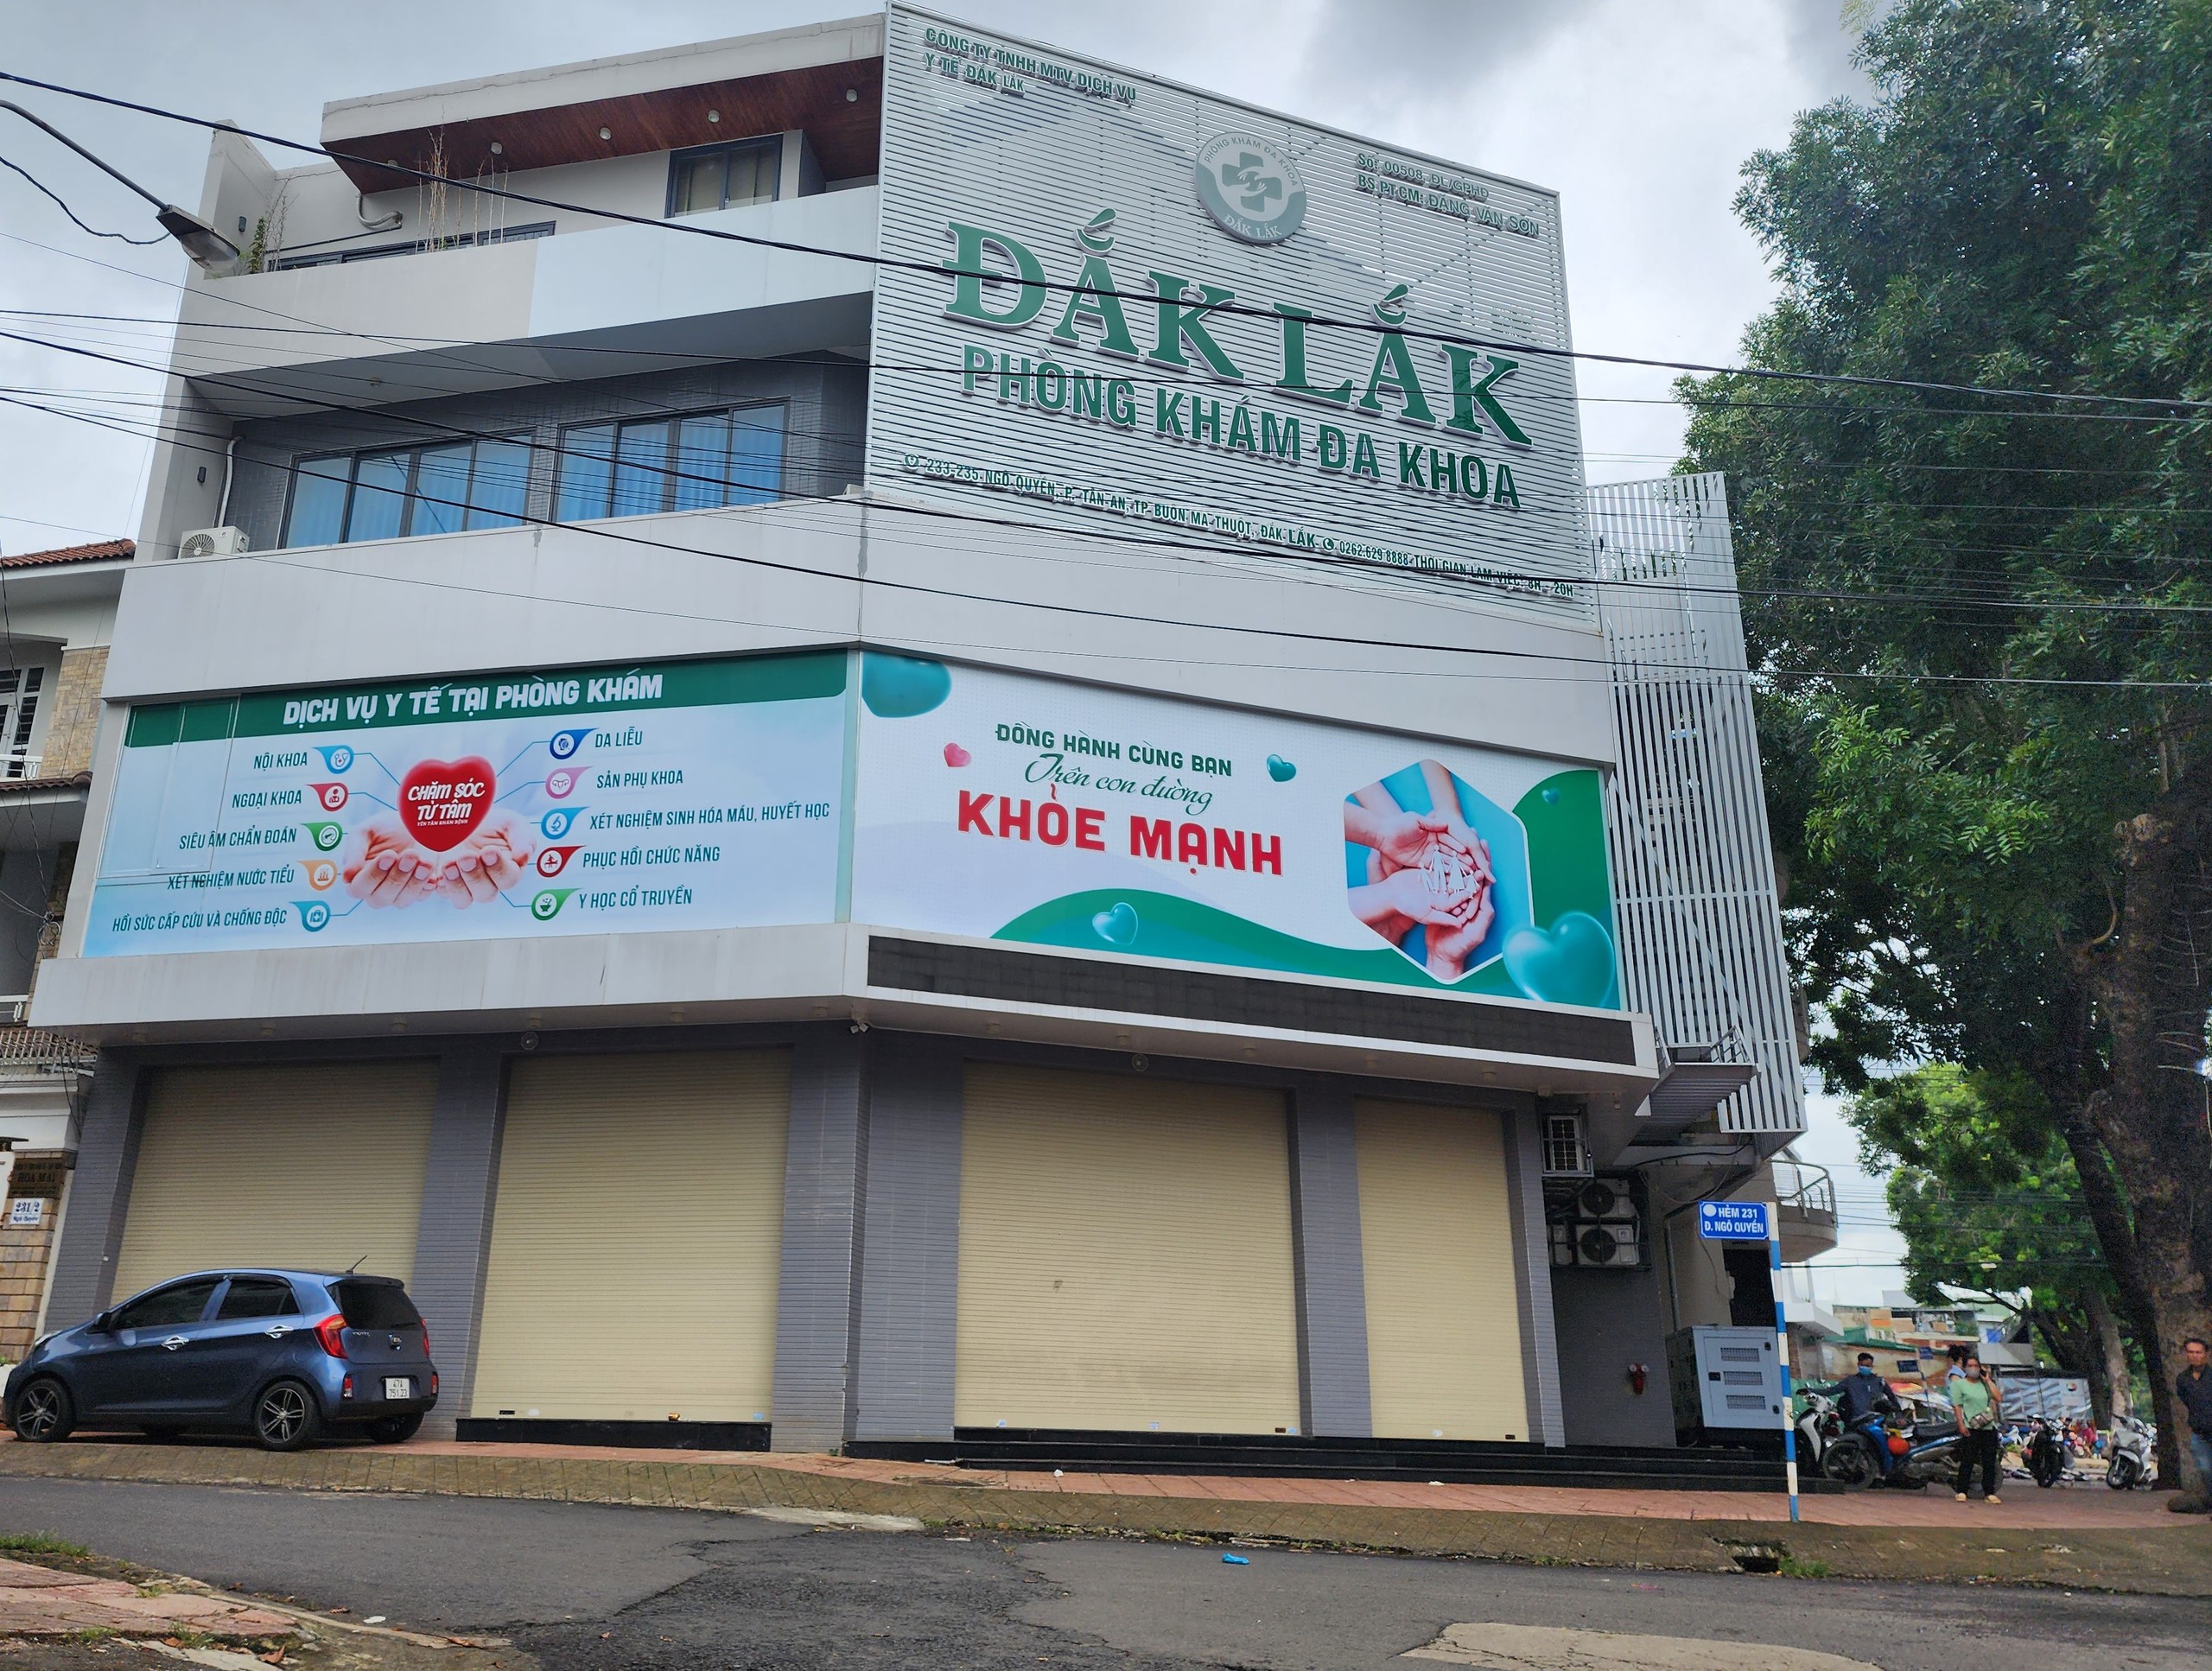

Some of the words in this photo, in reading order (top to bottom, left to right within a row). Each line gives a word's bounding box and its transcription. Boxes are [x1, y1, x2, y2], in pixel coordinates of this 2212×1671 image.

[925, 28, 969, 54] CÔNG
[973, 41, 992, 60] TY
[996, 48, 1037, 73] TNHH
[1039, 61, 1073, 84] MTV
[1077, 73, 1112, 95] DỊCH
[1116, 84, 1137, 105] VỤ
[925, 52, 935, 67] Y
[940, 54, 961, 75] TẾ
[966, 62, 998, 85] ĐẮK
[1002, 74, 1025, 92] LẮK
[1205, 139, 1230, 163] PHÒNG
[1231, 137, 1261, 149] KHÁM
[1264, 145, 1276, 159] ĐA
[1278, 159, 1298, 186] KHOA
[1358, 175, 1376, 190] BS
[1476, 205, 1503, 225] VĂN
[1510, 215, 1540, 235] SƠN
[1224, 214, 1251, 236] ĐẮK
[1255, 223, 1282, 238] LẮK
[941, 207, 1245, 383] ĐẮK
[1269, 283, 1533, 449] LẮK
[961, 344, 1137, 429] PHÒNG
[1154, 386, 1301, 465] KHÁM
[1315, 423, 1381, 482] ĐA
[1397, 441, 1521, 509] KHOA
[984, 469, 1010, 487] NGÔ
[1083, 487, 1104, 506] TÂN
[1154, 503, 1185, 522] BUÔN
[1191, 511, 1209, 527] MA
[1261, 522, 1282, 541] ĐẮK
[1288, 526, 1315, 548] LẮK
[1339, 540, 1382, 561] 0262.629
[1386, 550, 1408, 566] 8888
[1442, 561, 1466, 576] GIAN
[1554, 581, 1573, 597] 20H
[283, 698, 339, 729] DỊCH
[346, 695, 378, 724] VỤ
[385, 692, 403, 716] Y
[409, 683, 454, 715] TẾ
[449, 686, 488, 717] TẠI
[495, 674, 580, 709] PHÒNG
[587, 667, 664, 703] KHÁM
[594, 732, 611, 748] DA
[615, 726, 644, 747] LIỄU
[995, 721, 1054, 749] ĐỒNG
[1064, 730, 1121, 759] HÀNH
[1128, 740, 1184, 769] CÙNG
[1192, 754, 1232, 778] BẠN
[254, 752, 273, 772] NỘI
[276, 752, 308, 768] KHOA
[454, 778, 486, 798] SÓC
[596, 770, 620, 789] SẢN
[623, 772, 647, 789] PHỤ
[651, 770, 683, 785] KHOA
[1025, 753, 1090, 786] Trên
[1096, 775, 1137, 794] con
[1141, 775, 1213, 816] đường
[232, 792, 268, 809] NGOẠI
[270, 790, 302, 805] KHOA
[439, 799, 473, 820] TÂM
[589, 811, 613, 830] XÉT
[616, 810, 663, 829] NGHIỆM
[666, 809, 696, 826] SINH
[698, 806, 723, 824] HÓA
[726, 804, 758, 823] MÁU,
[761, 800, 802, 820] HUYẾT
[804, 802, 830, 821] HỌC
[179, 831, 206, 849] SIÊU
[207, 829, 226, 848] ÂM
[229, 824, 260, 846] CHẨN
[264, 827, 296, 844] ĐOÁN
[957, 783, 1107, 853] KHỎE
[1129, 815, 1283, 877] MẠNH
[582, 851, 617, 869] PHỤC
[620, 846, 642, 867] HỒI
[645, 846, 681, 865] CHỨC
[683, 844, 721, 863] NĂNG
[191, 870, 234, 889] NGHIỆM
[237, 868, 266, 886] NƯỚC
[270, 864, 295, 884] TIỂU
[579, 893, 588, 910] Y
[590, 893, 618, 912] HỌC
[620, 885, 639, 908] CỔ
[641, 884, 693, 906] TRUYỀN
[112, 913, 130, 931] HỒI
[134, 913, 155, 931] SỨC
[157, 911, 179, 930] CẤP
[182, 911, 204, 929] CỨU
[207, 911, 220, 928] VÀ
[224, 907, 261, 926] CHỐNG
[264, 908, 288, 926] ĐỘC
[1704, 1220, 1713, 1231] Đ.
[1741, 1208, 1758, 1218] 231
